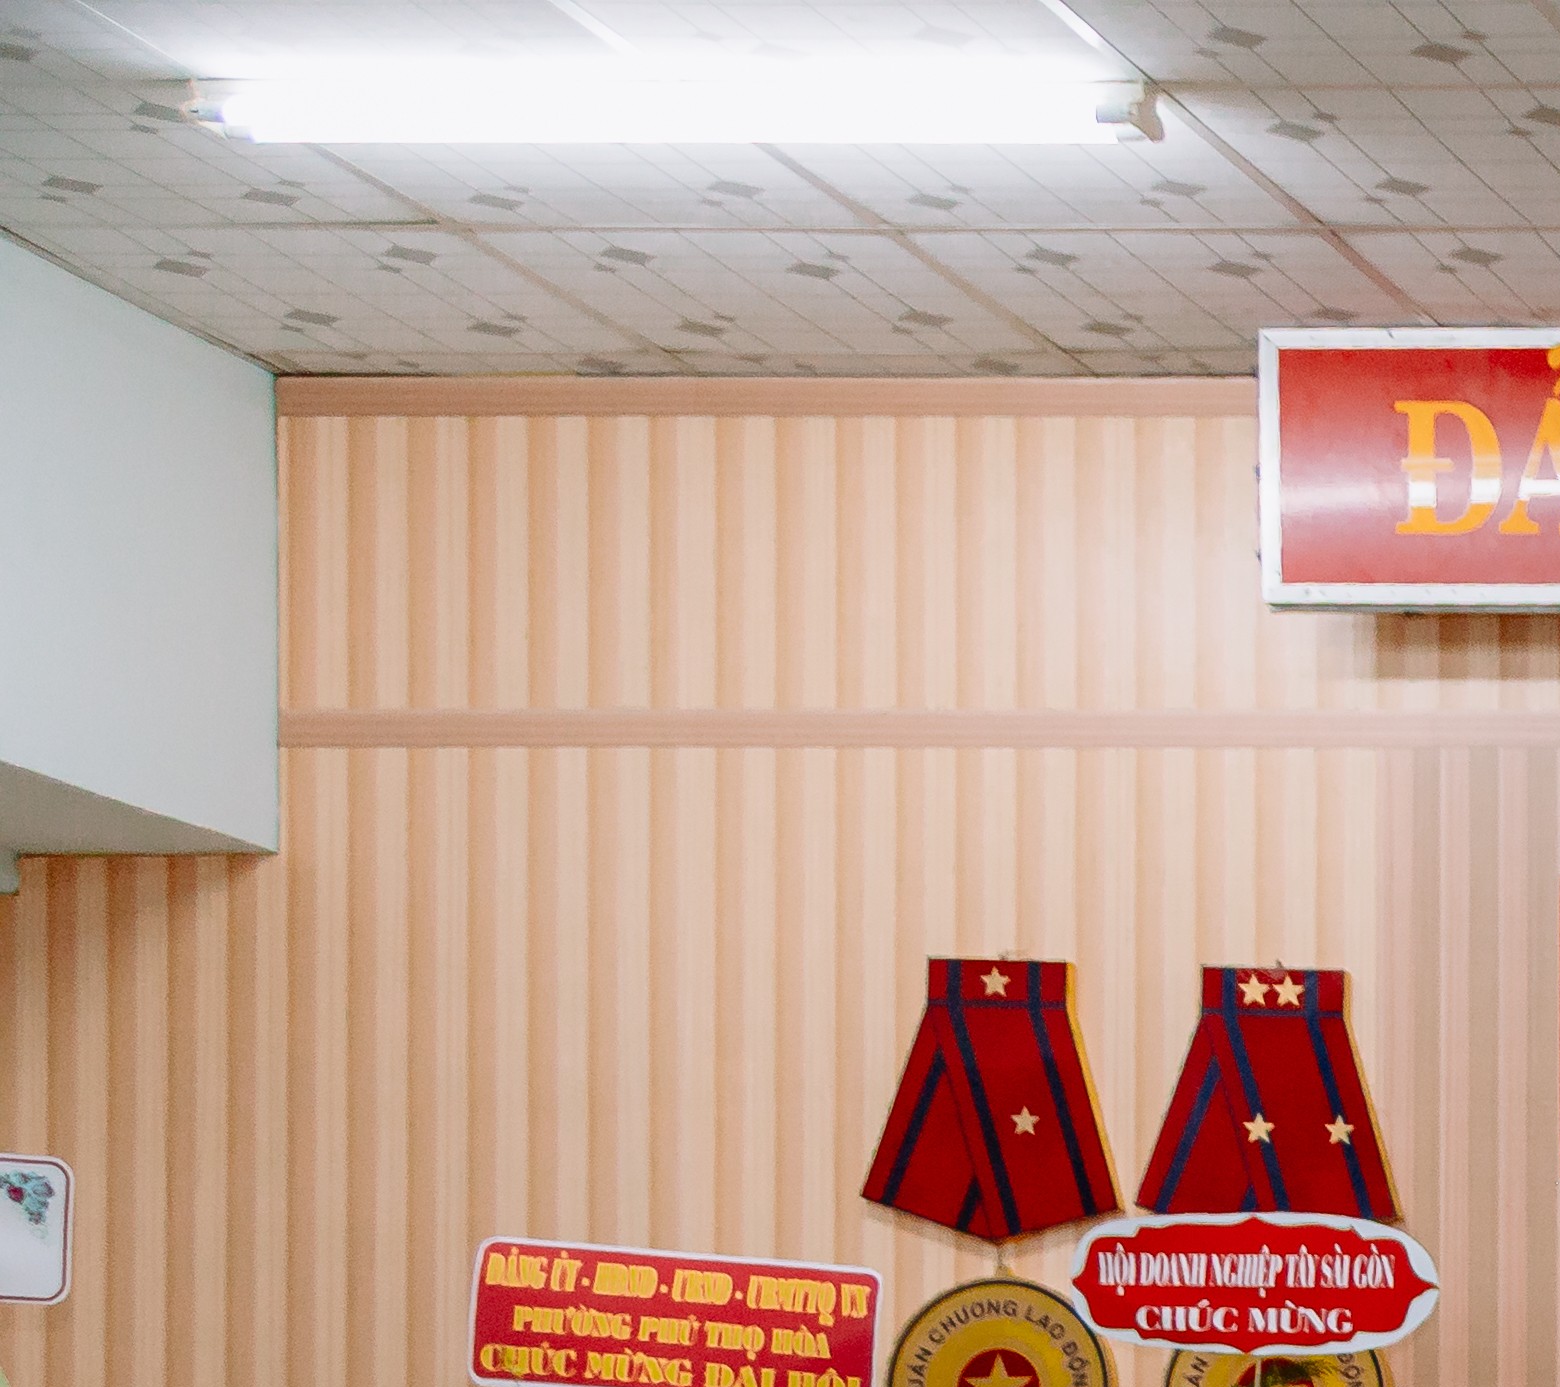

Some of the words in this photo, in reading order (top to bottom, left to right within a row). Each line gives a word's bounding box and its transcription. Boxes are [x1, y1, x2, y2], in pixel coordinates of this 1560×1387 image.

[513, 1303, 633, 1341] PHƯỜNG
[637, 1314, 700, 1347] PHÚ
[705, 1320, 766, 1362] THỌ
[771, 1321, 832, 1360] HÒA
[1134, 1300, 1239, 1333] CHÚC
[1248, 1300, 1353, 1333] MỪNG
[479, 1340, 577, 1379] CHÚC
[584, 1347, 694, 1387] MỪNG
